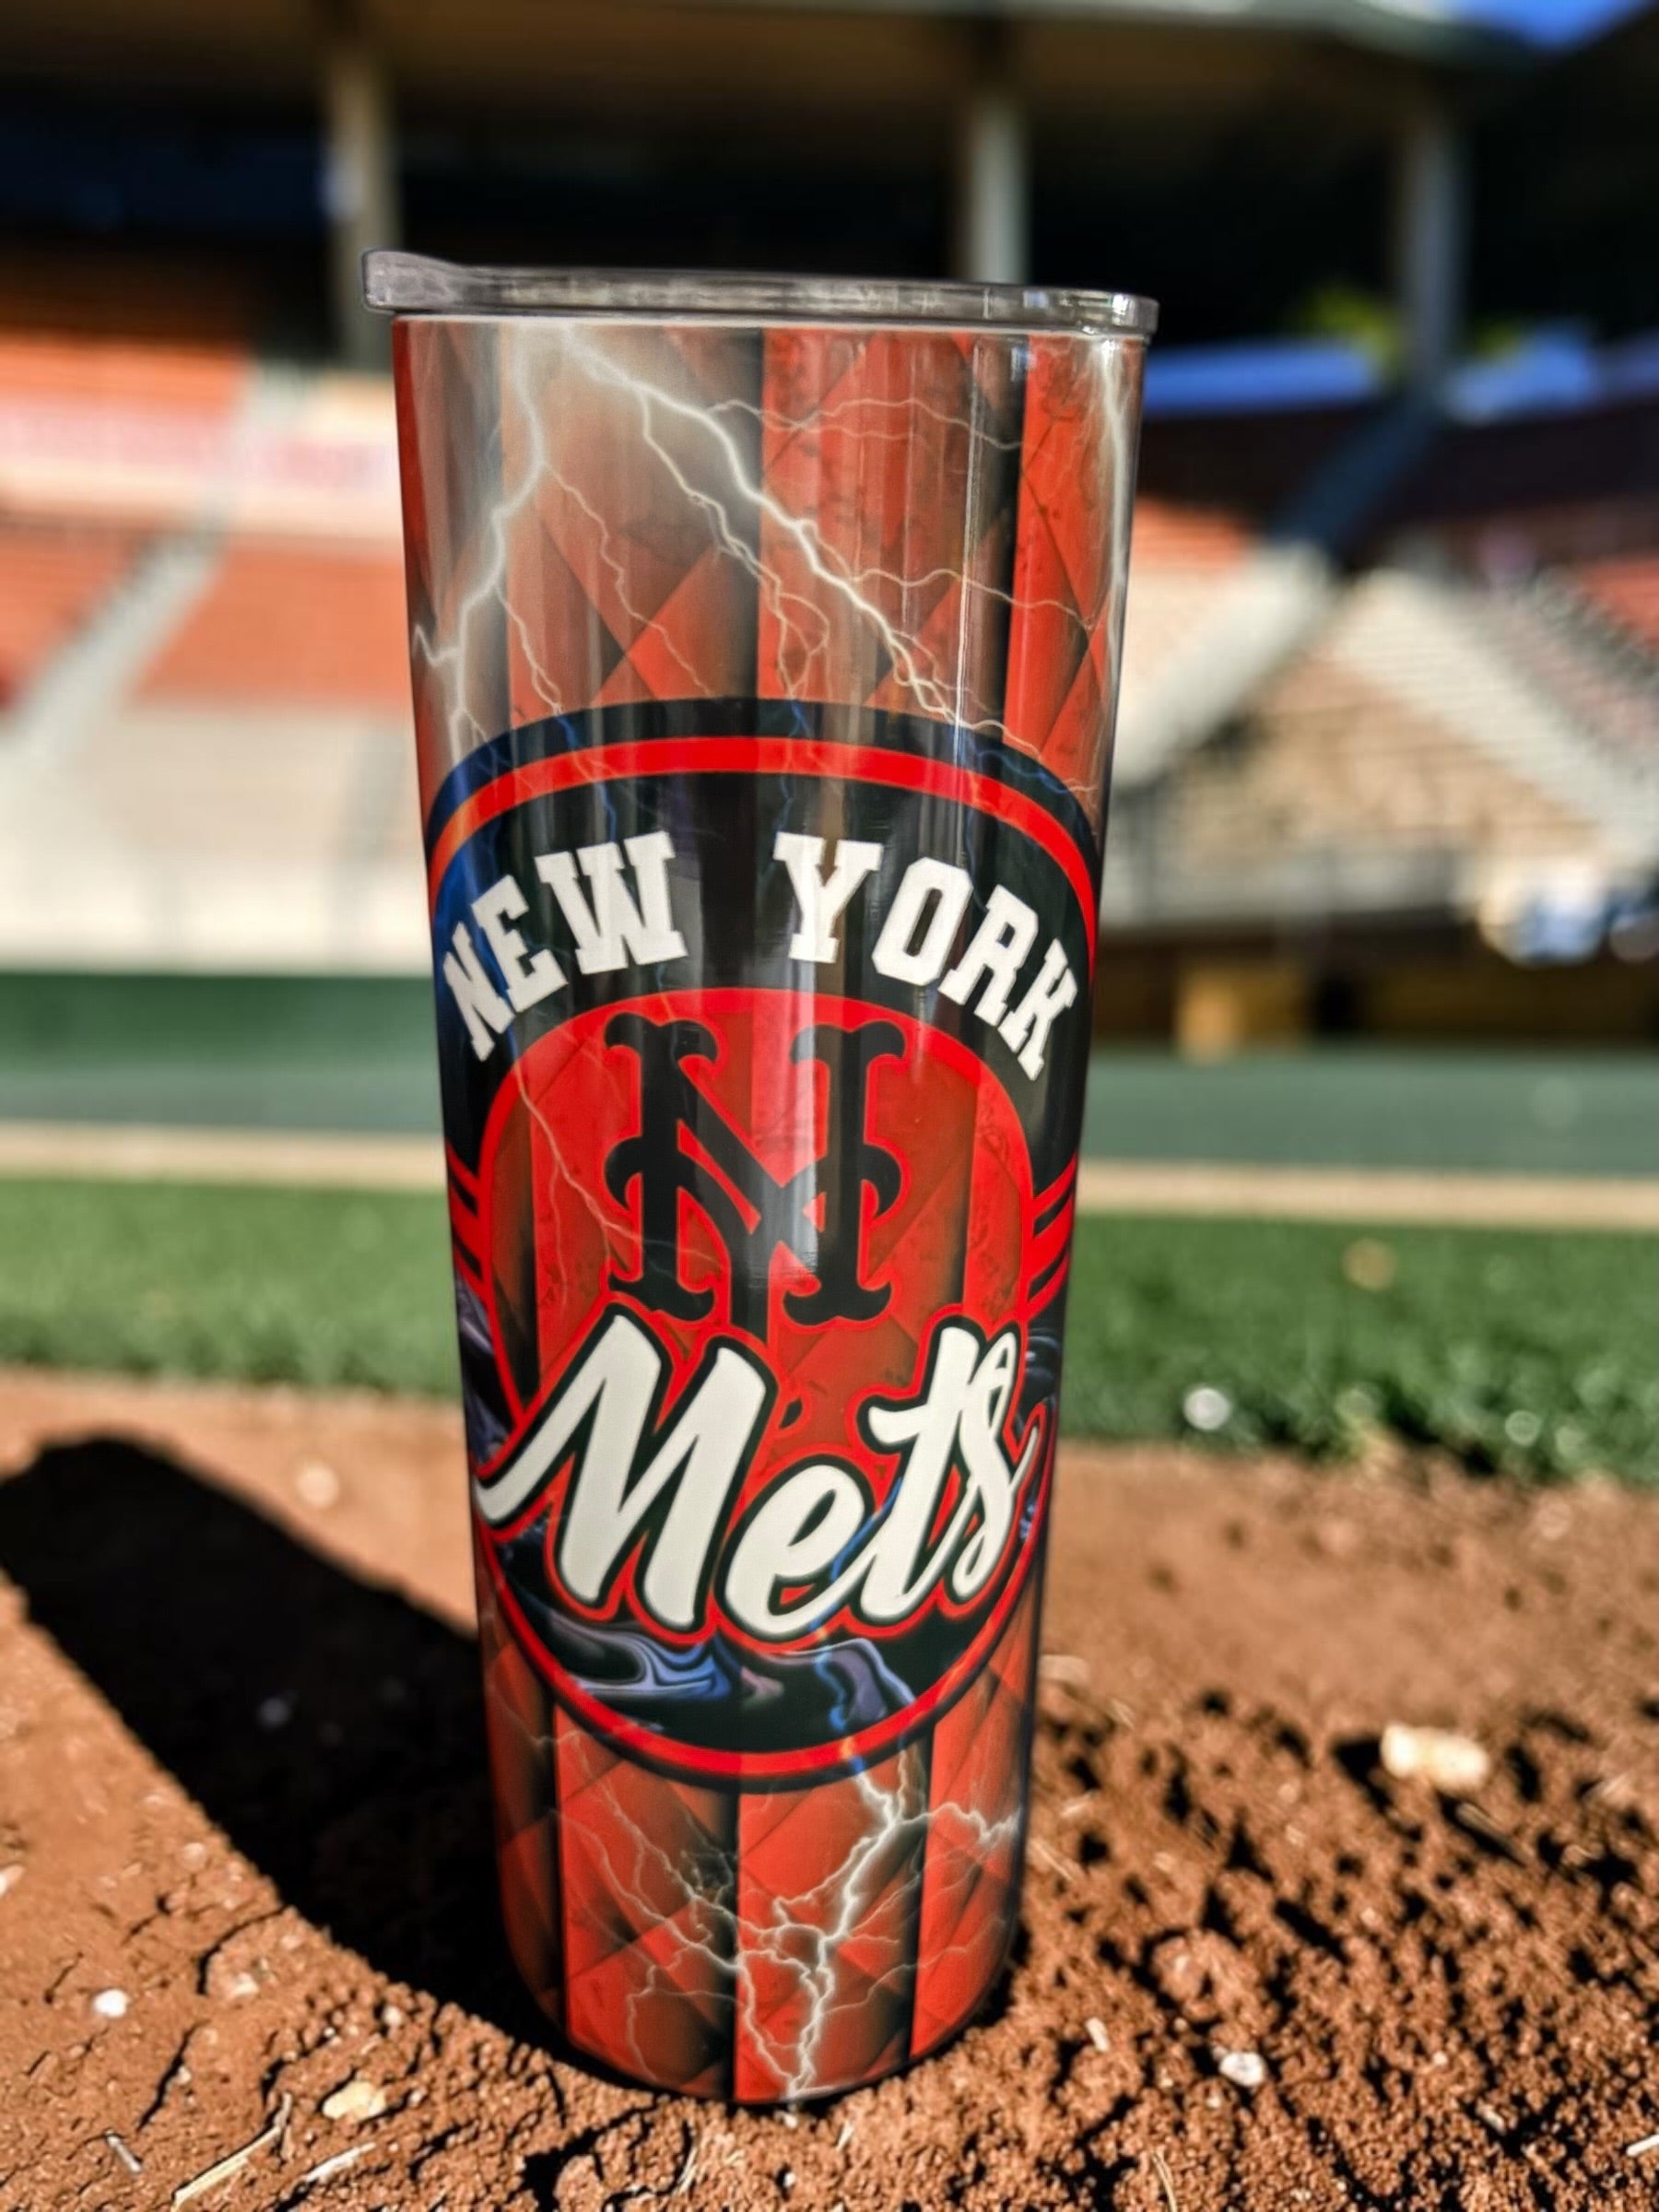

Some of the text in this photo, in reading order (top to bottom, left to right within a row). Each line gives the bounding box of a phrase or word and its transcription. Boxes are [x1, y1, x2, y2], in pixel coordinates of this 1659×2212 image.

[442, 830, 1078, 1082] NEW YORK
[475, 1312, 1040, 1635] Mets
